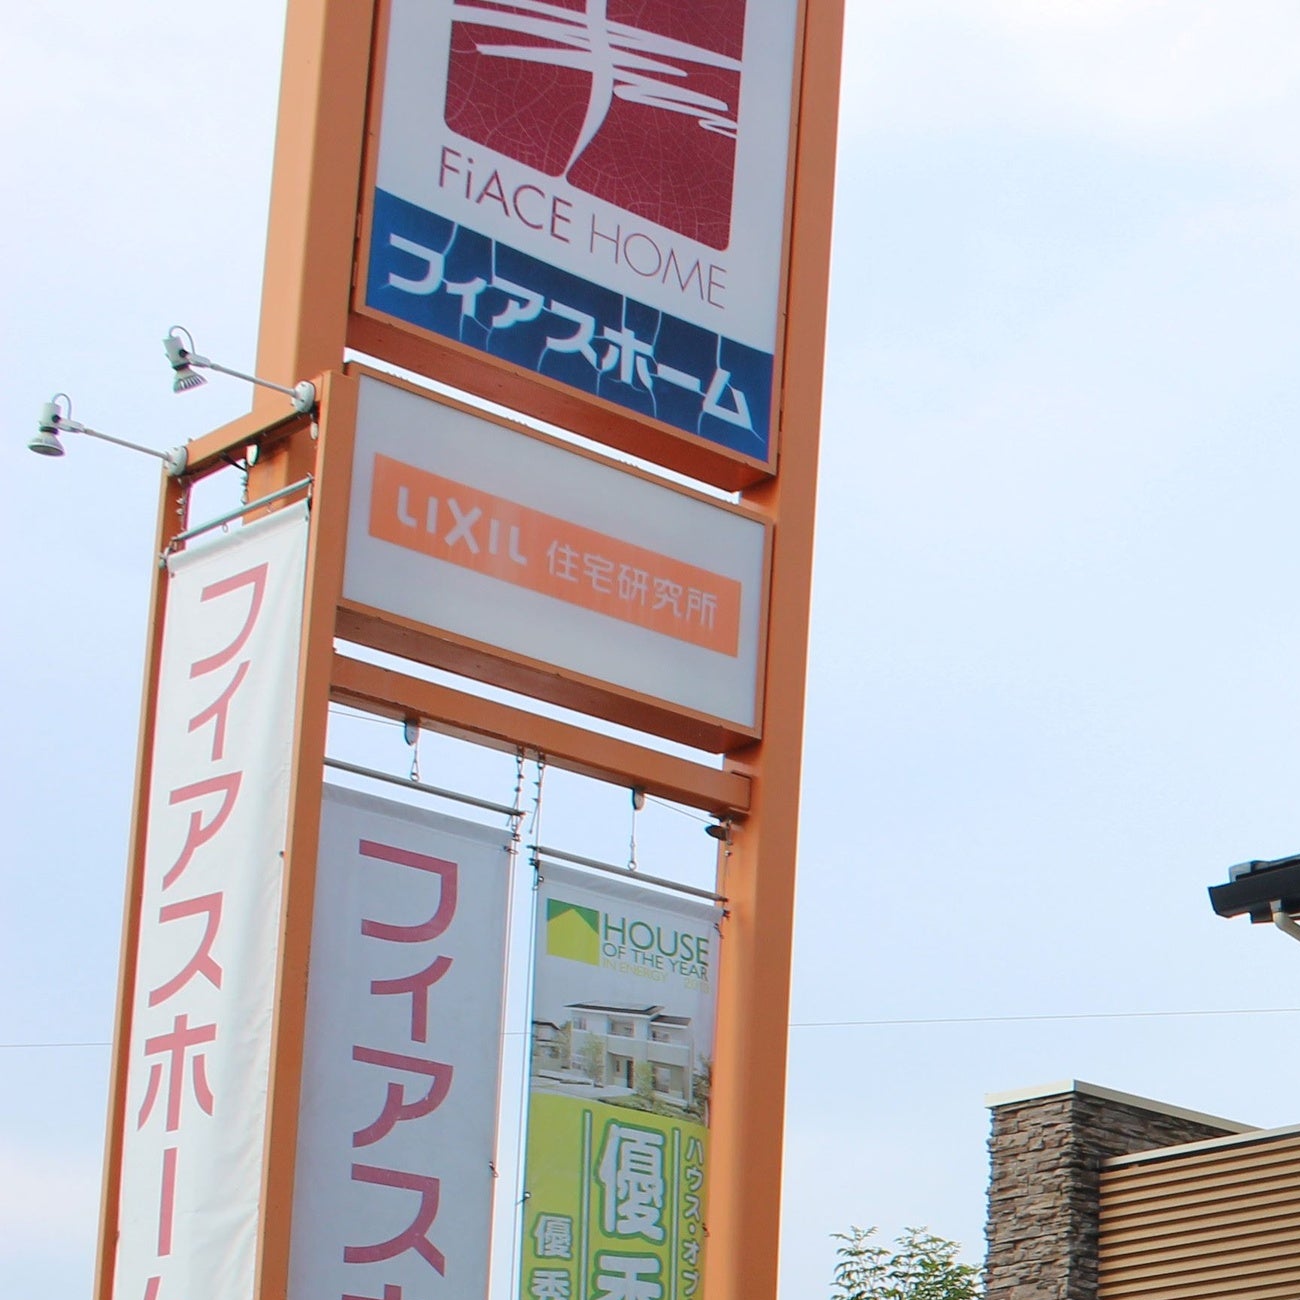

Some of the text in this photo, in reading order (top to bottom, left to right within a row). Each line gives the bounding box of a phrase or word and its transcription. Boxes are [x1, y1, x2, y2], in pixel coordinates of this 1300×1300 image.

[438, 145, 728, 311] FiACE HOME
[388, 232, 752, 430] フィアスホーム
[397, 486, 718, 632] LIXIL 住宅研究所
[602, 959, 616, 971] IN
[619, 962, 667, 984] ENERGY
[603, 943, 709, 981] OF THE YEAR
[604, 914, 709, 967] HOUSE
